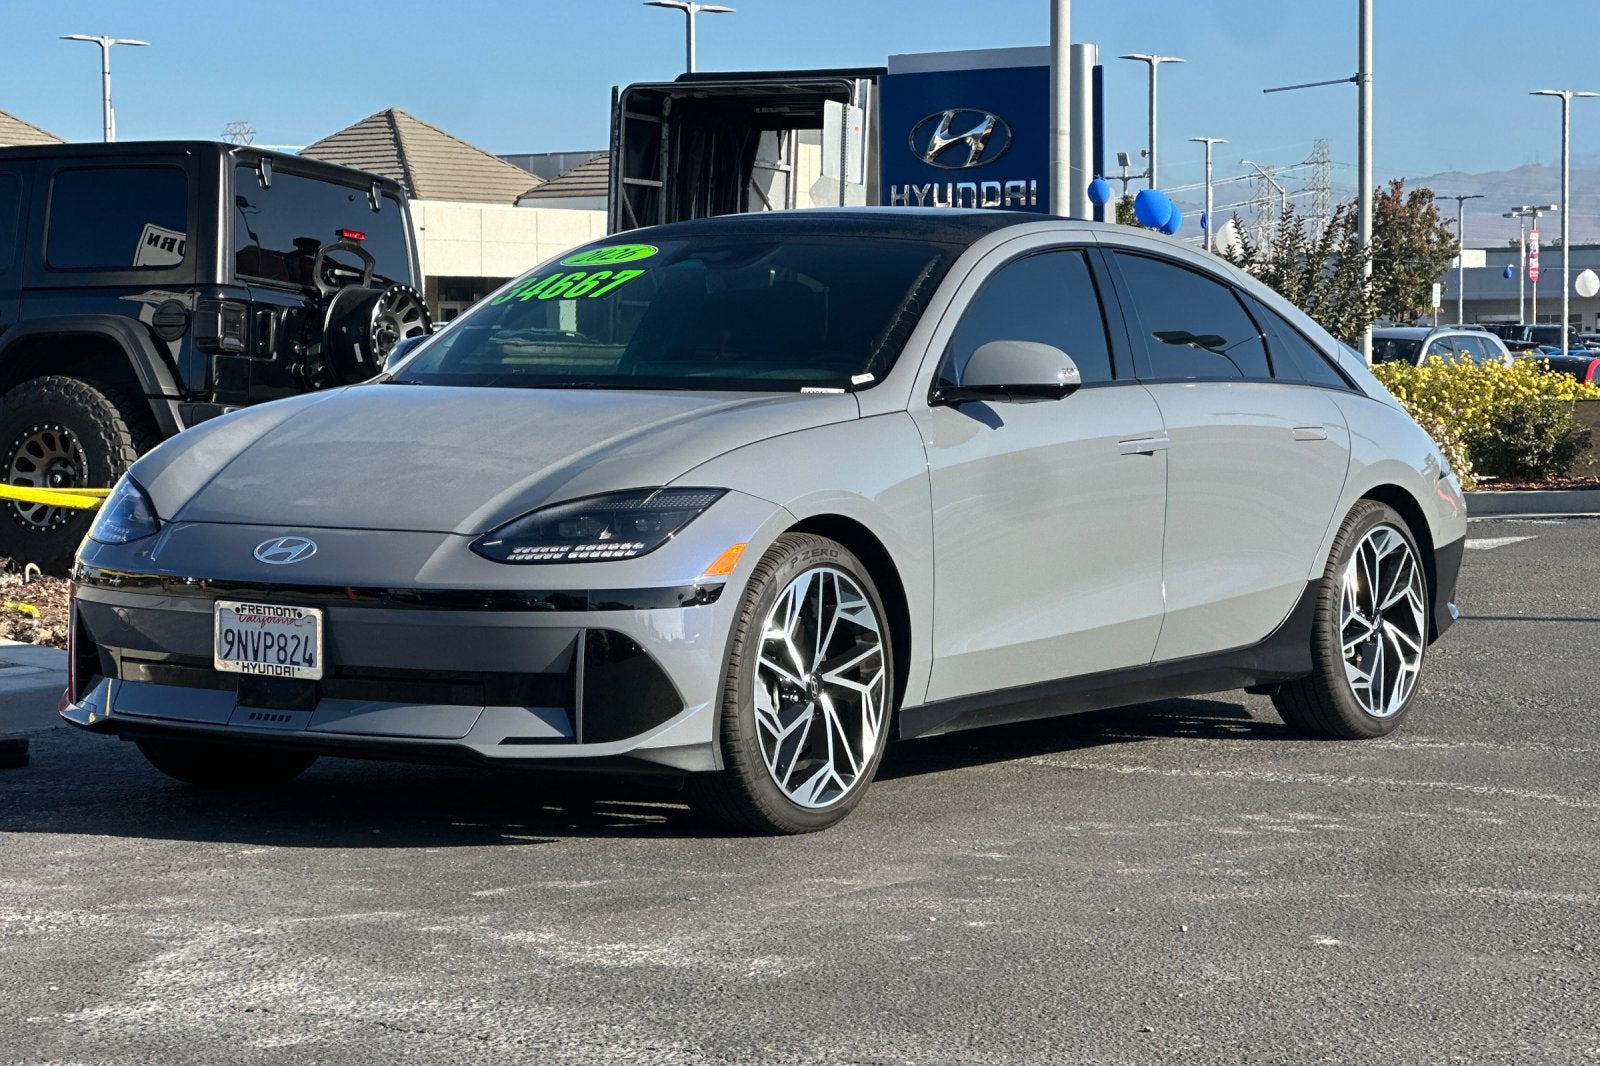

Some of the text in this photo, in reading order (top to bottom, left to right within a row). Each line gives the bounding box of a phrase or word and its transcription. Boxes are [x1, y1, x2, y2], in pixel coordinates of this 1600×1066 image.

[890, 180, 1037, 208] HYUNDAI
[490, 269, 646, 306] 34667
[239, 614, 303, 629] California
[240, 604, 298, 618] FREMONT
[223, 628, 314, 668] 9NVP824
[241, 661, 295, 677] HYUNDAI
